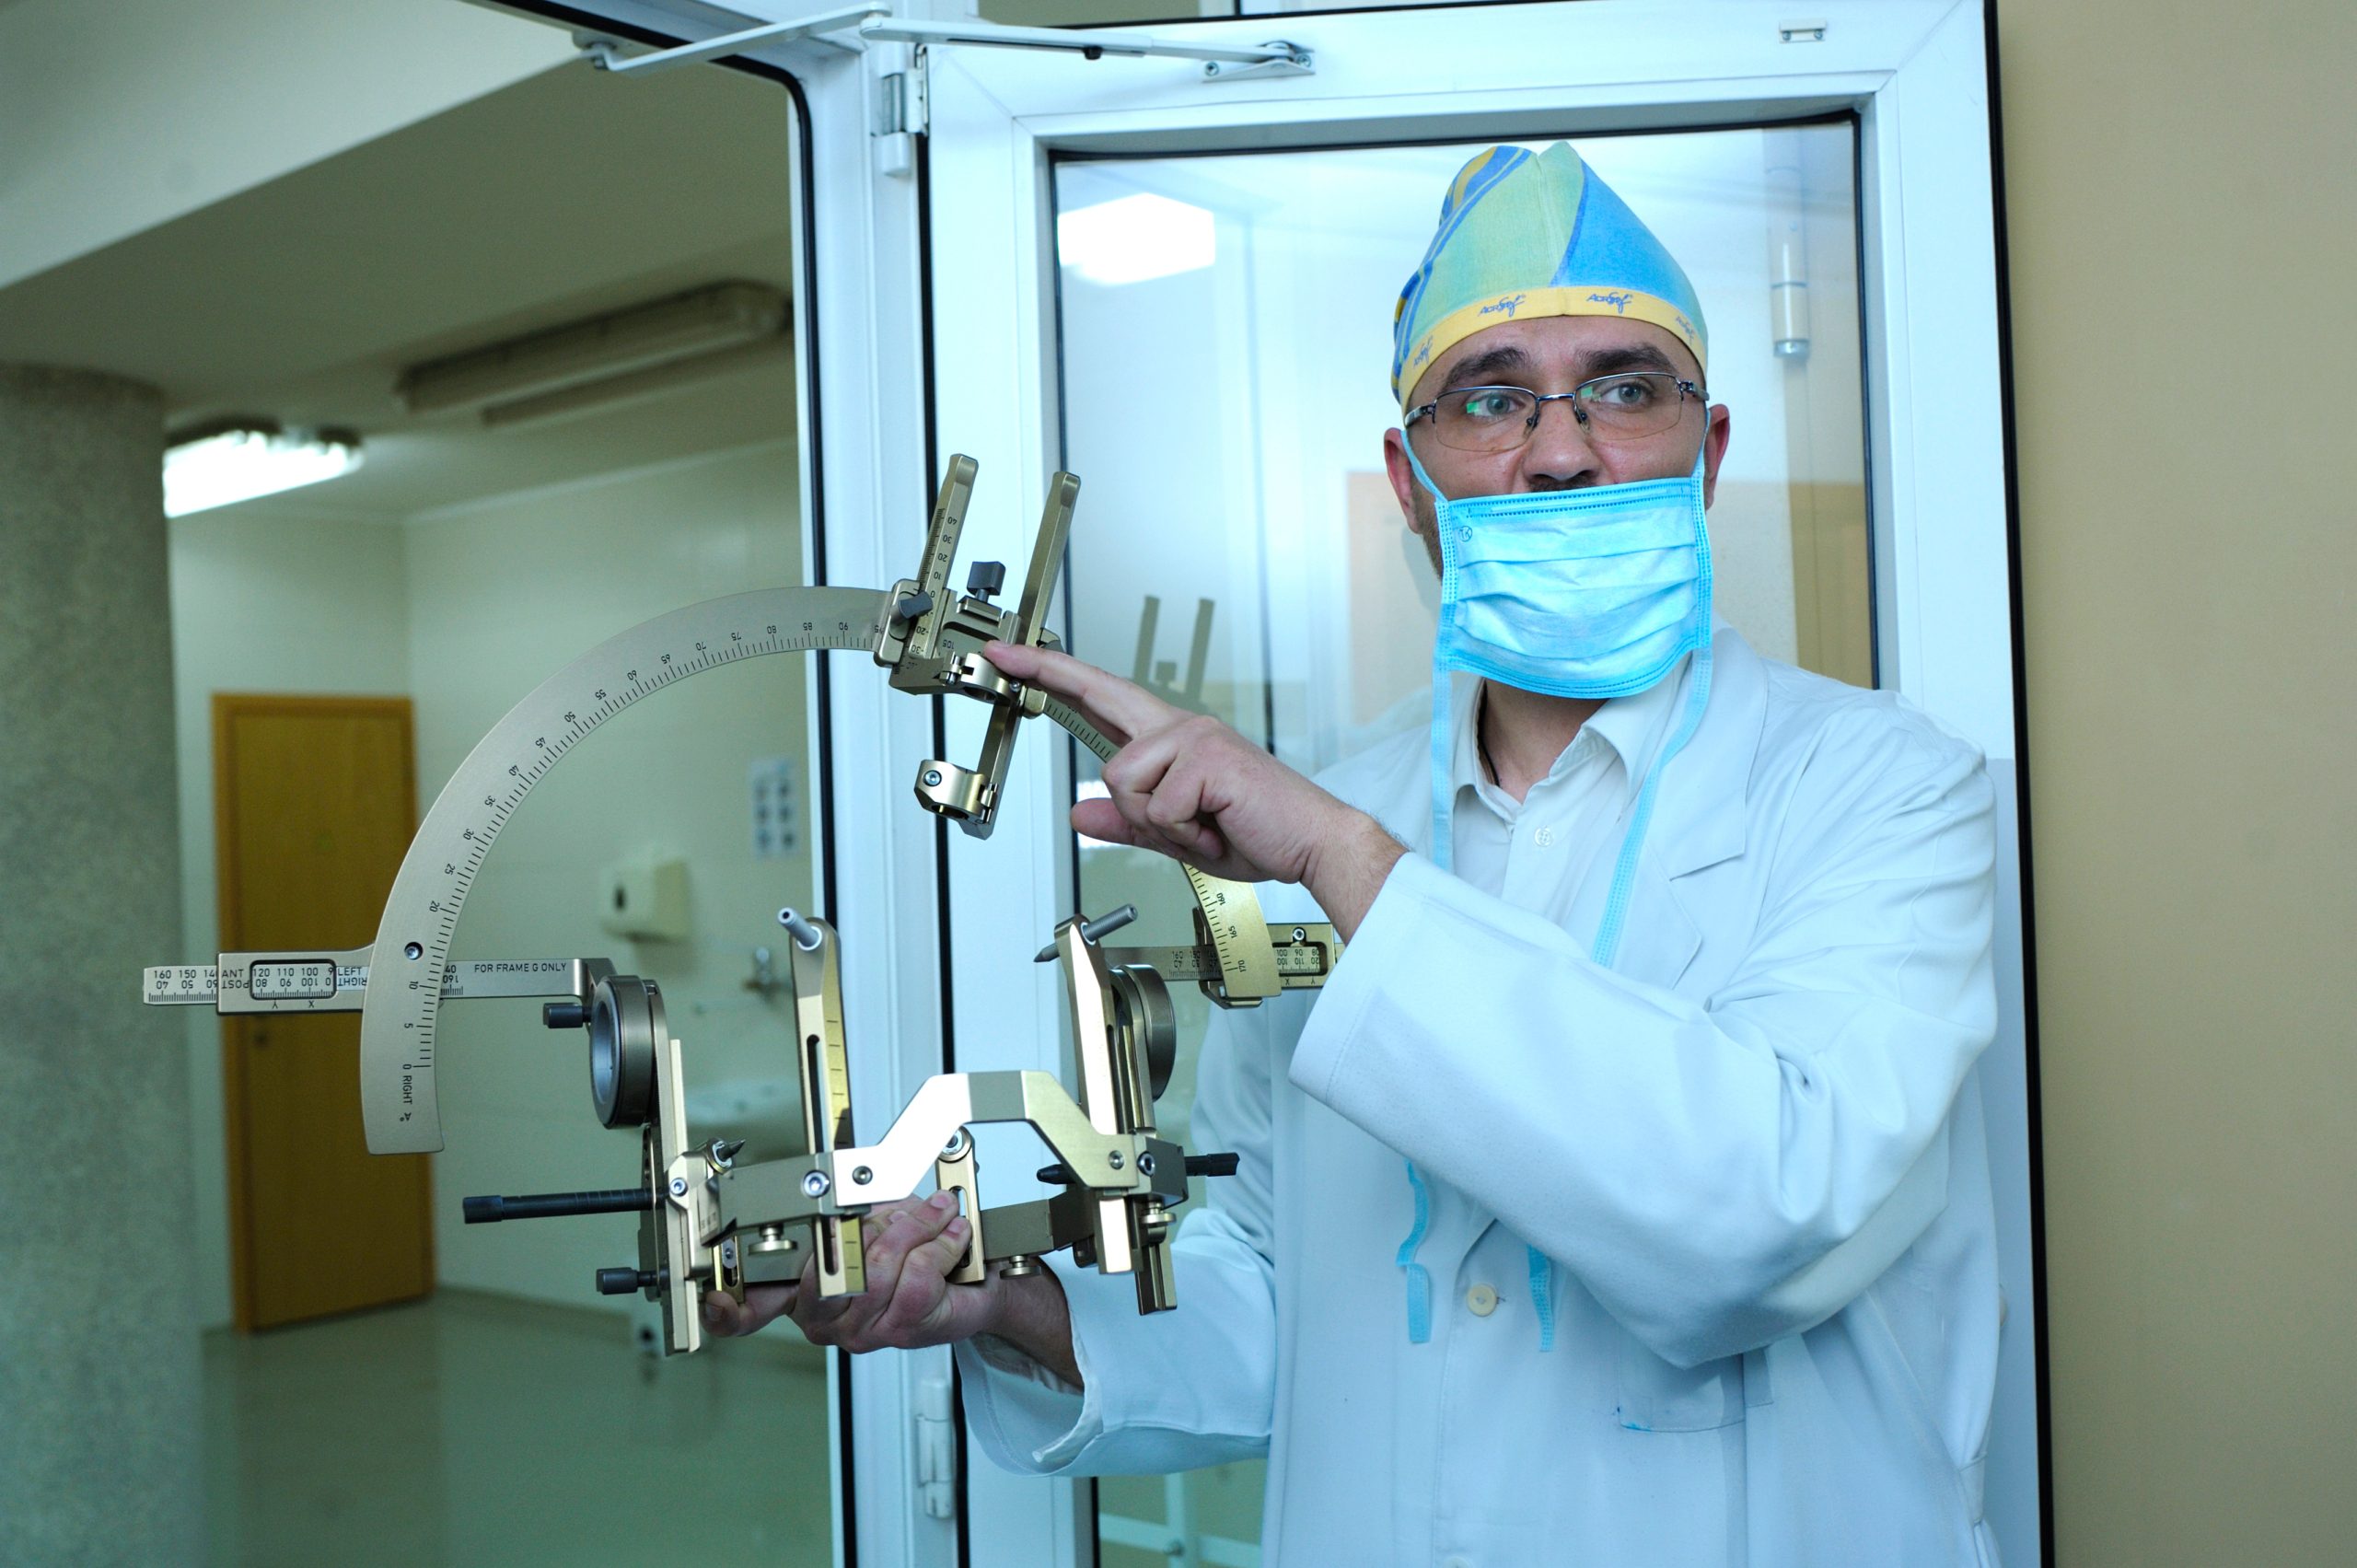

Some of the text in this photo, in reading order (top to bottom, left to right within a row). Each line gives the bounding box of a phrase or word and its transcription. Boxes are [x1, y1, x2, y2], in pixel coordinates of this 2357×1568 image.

[947, 517, 958, 525] 40
[943, 535, 952, 544] 30
[937, 552, 948, 563] 20
[934, 572, 942, 580] 10
[767, 625, 777, 634] 80
[803, 622, 813, 631] 85
[839, 622, 849, 631] 90
[731, 633, 741, 641] 75
[695, 642, 707, 651] 70
[943, 639, 954, 649] 105
[660, 654, 671, 664] 65
[627, 669, 637, 680] 60
[595, 689, 607, 701] 55
[563, 711, 576, 723] 50
[535, 737, 546, 749] 45
[508, 765, 519, 776] 40
[484, 796, 496, 807] 35
[463, 829, 474, 841] 30
[445, 863, 456, 876] 25
[429, 900, 440, 912] 20
[1216, 892, 1247, 972] 160 165 170
[1295, 948, 1304, 957] 90
[253, 968, 270, 977] 120
[277, 968, 295, 976] 110
[302, 967, 319, 976] 100
[338, 967, 362, 976] LEFT
[474, 962, 566, 973] FOR FRAME G ONLY
[154, 970, 217, 979] 160 150 14
[222, 970, 244, 978] ANT
[255, 979, 267, 987] 80
[280, 978, 292, 987] 90
[301, 978, 318, 986] 100
[338, 977, 367, 986] RIGHT
[443, 975, 459, 983] 160
[156, 981, 168, 989] 40
[181, 980, 193, 989] 50
[222, 980, 250, 989] POST
[409, 981, 419, 990] 10
[308, 1000, 315, 1008] X
[402, 1074, 412, 1105] RIGHT
